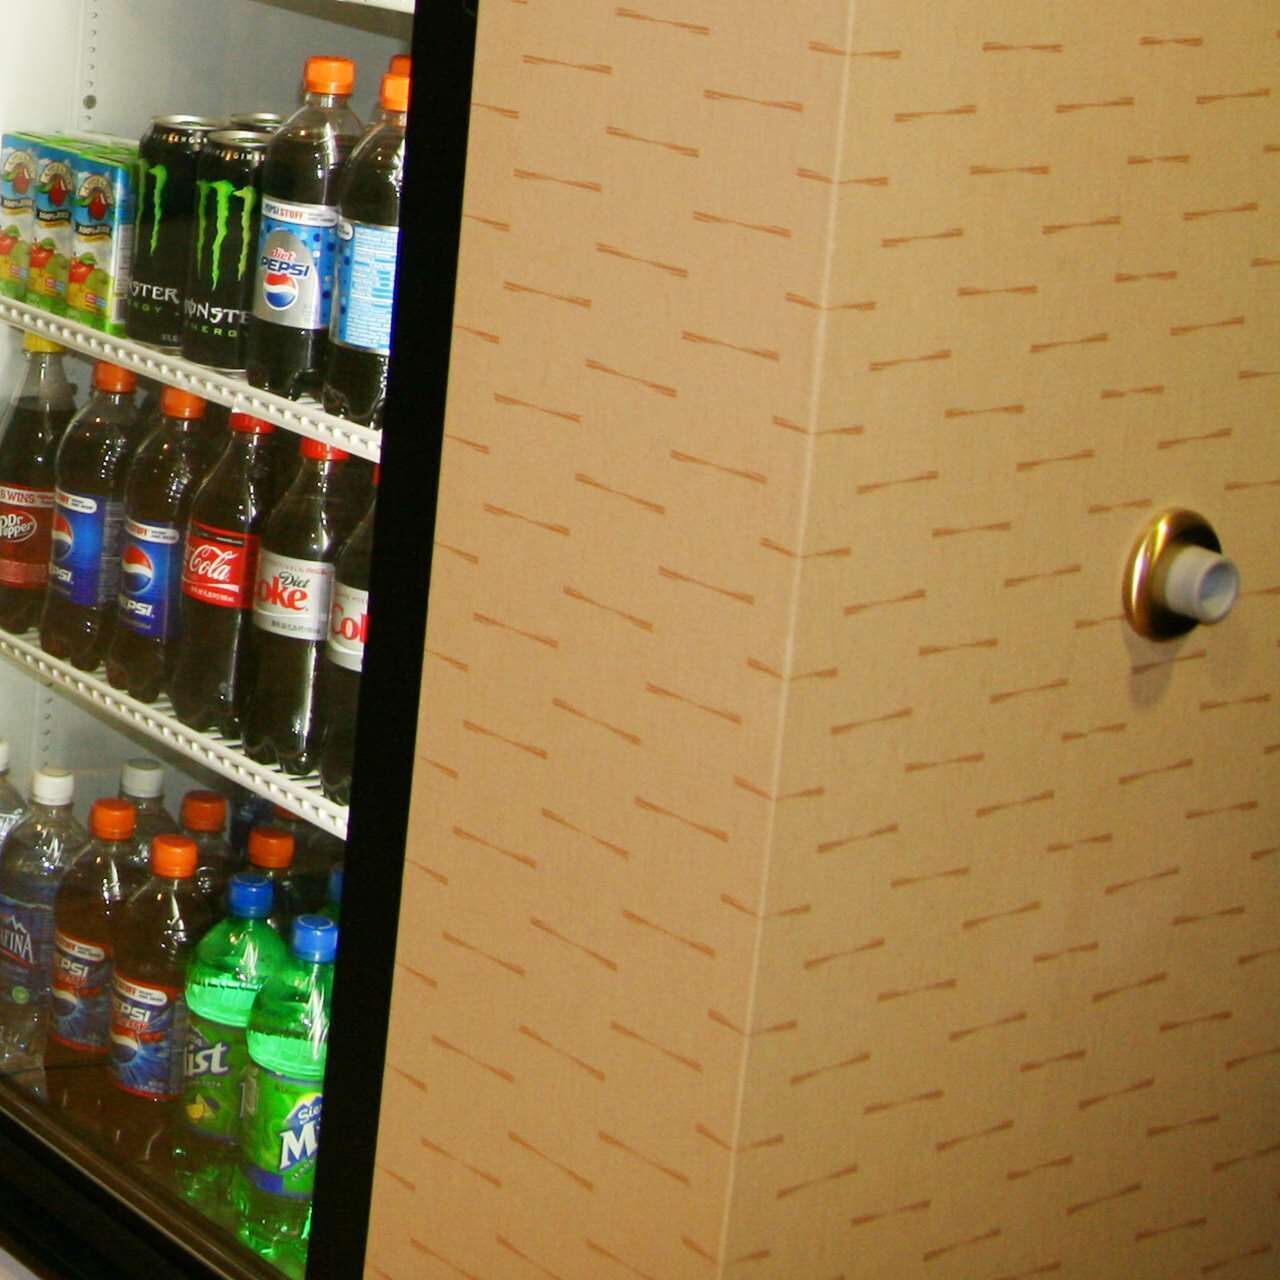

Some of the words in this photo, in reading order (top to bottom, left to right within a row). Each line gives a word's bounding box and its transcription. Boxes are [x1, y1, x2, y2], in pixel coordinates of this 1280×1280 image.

[272, 247, 297, 261] diet
[262, 256, 311, 278] PEPSI
[7, 489, 35, 504] WINS
[7, 513, 24, 527] Dr
[190, 544, 238, 582] Cola
[279, 572, 310, 588] Diet
